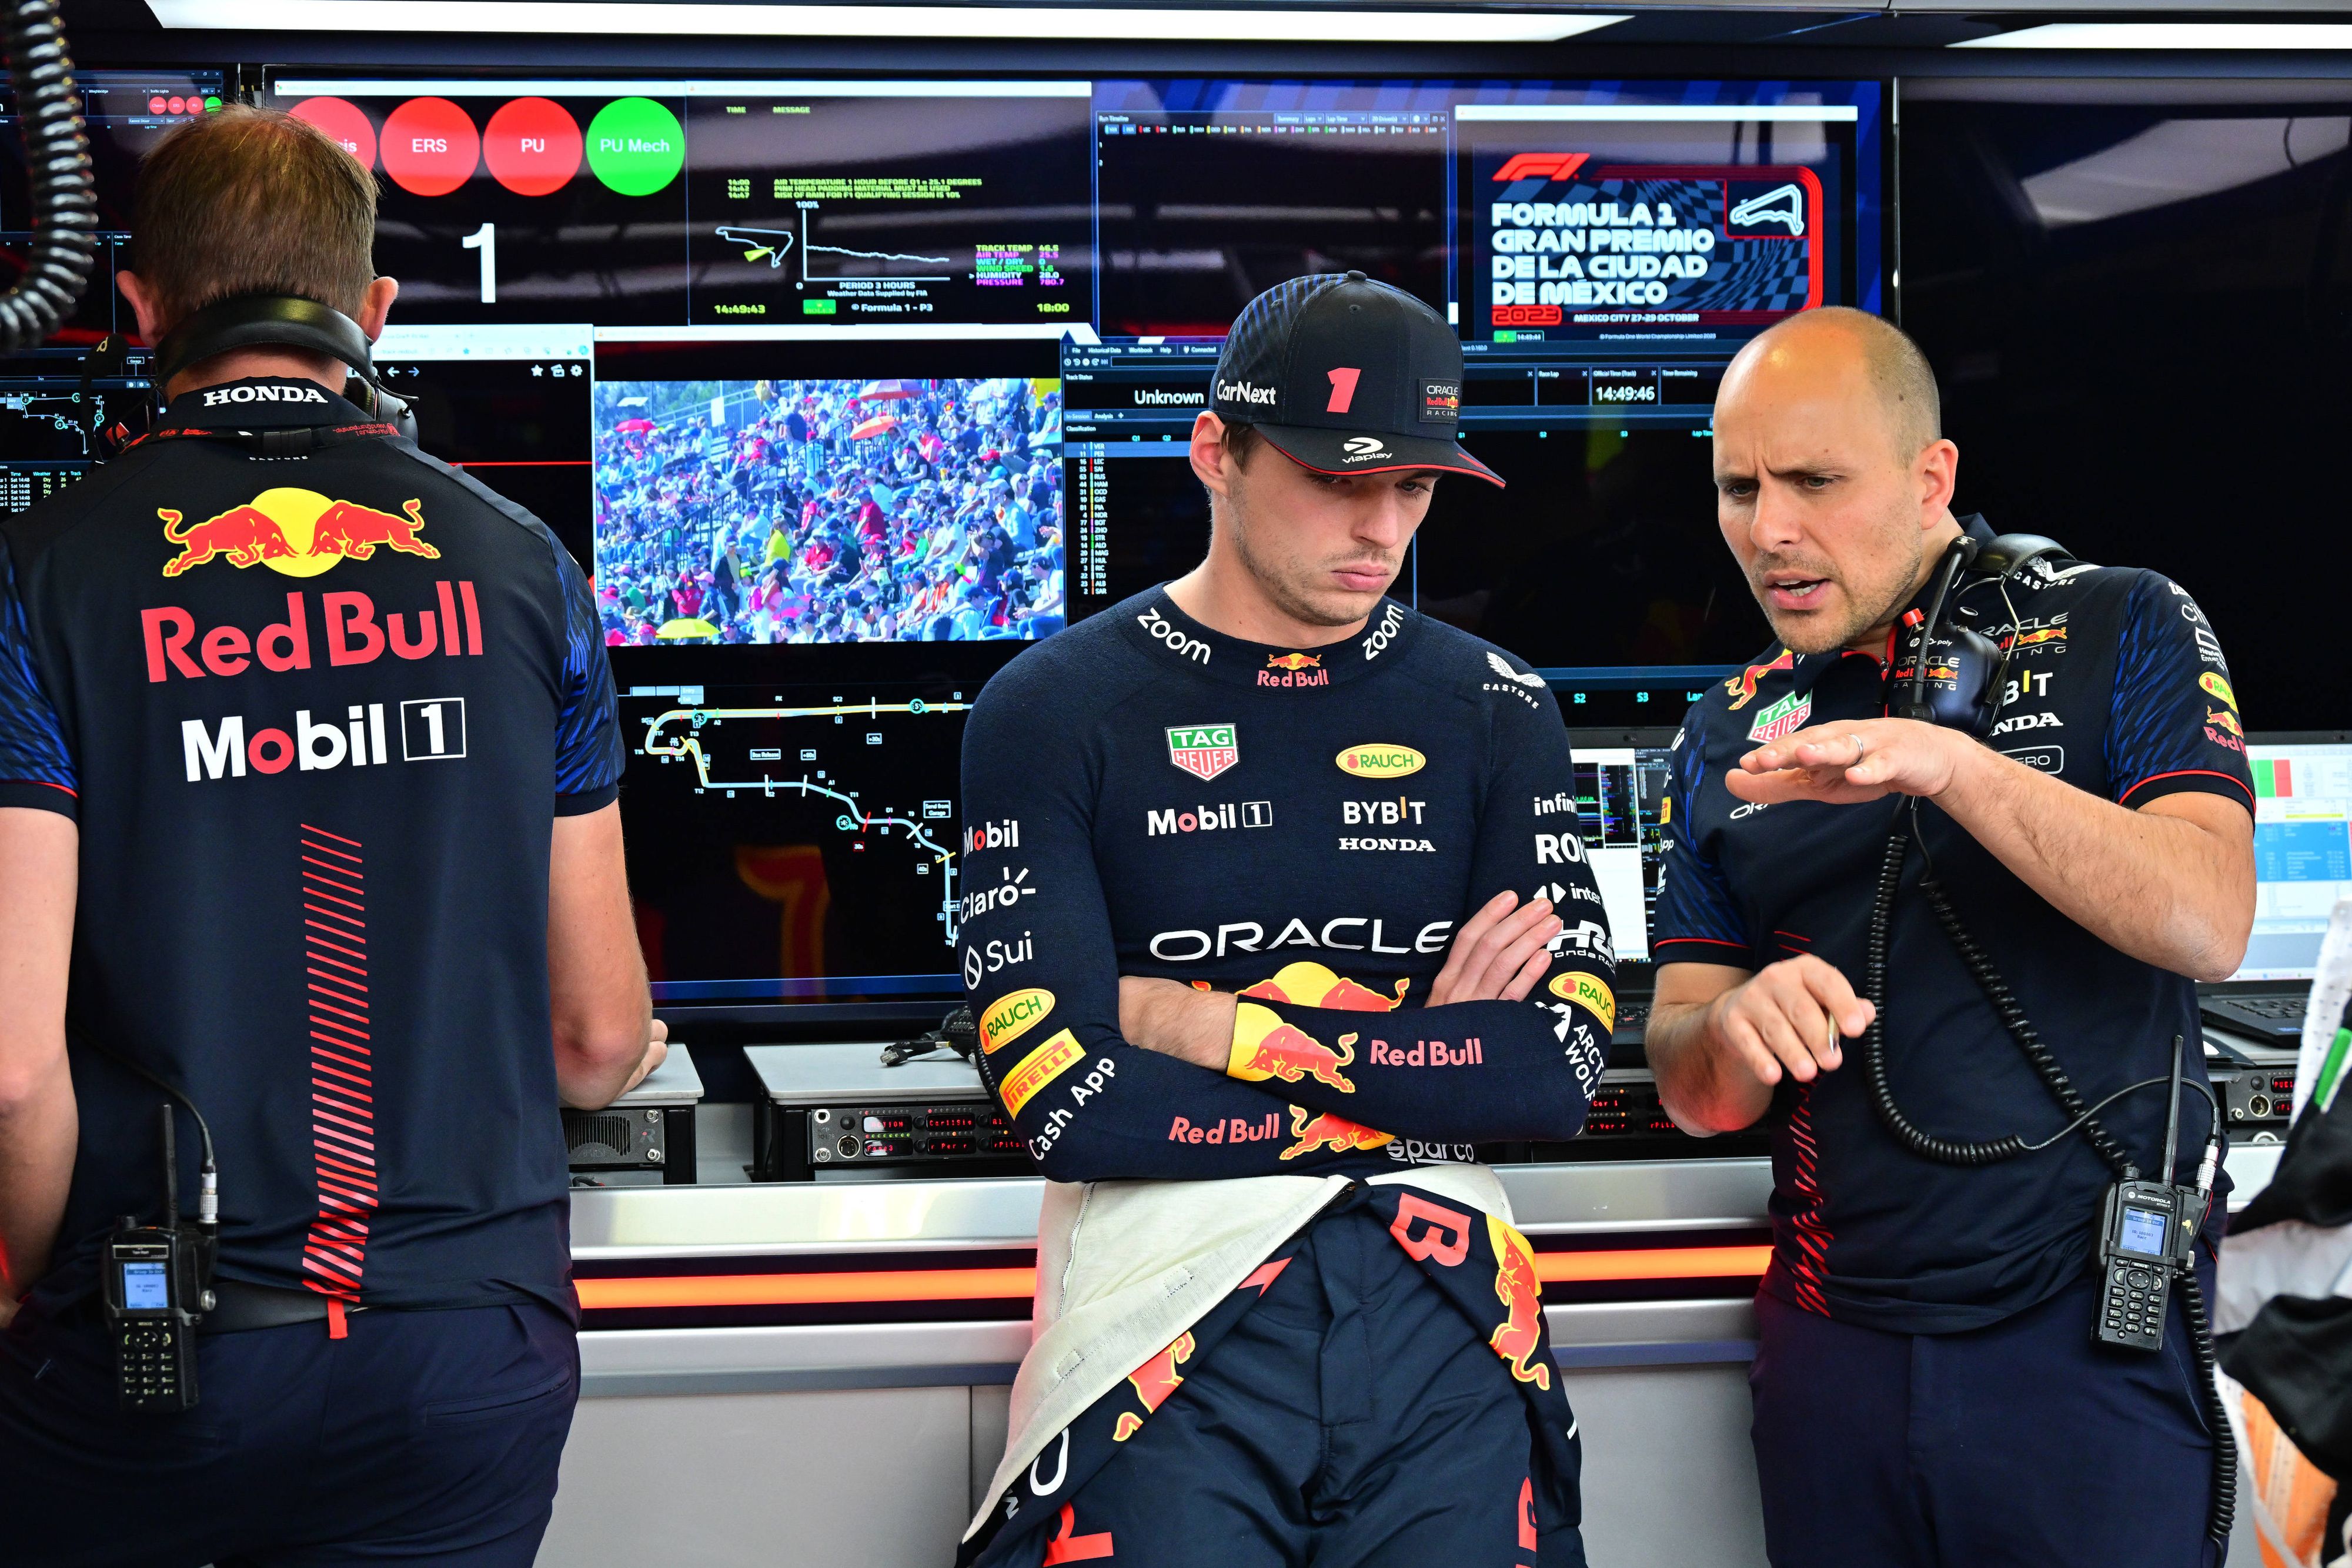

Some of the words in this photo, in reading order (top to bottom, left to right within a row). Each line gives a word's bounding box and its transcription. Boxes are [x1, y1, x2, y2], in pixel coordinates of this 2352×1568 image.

[773, 106, 811, 114] MESSAGE
[412, 139, 447, 152] ERS
[522, 139, 544, 152] PU
[600, 139, 623, 152] PU
[628, 139, 670, 152] Mech
[1492, 153, 1590, 181] F1
[796, 200, 819, 209] 100%
[1492, 202, 1654, 227] FORMULA
[1658, 203, 1676, 226] 1
[1492, 229, 1585, 253] GRAN
[1589, 229, 1715, 253] PREMIO
[463, 223, 496, 303] 1
[1492, 255, 1536, 279] DE
[1539, 255, 1585, 279] LA
[1589, 255, 1708, 279] CIUDAD
[1492, 282, 1536, 305] DE
[1539, 278, 1668, 305] MÉXICO
[714, 305, 765, 313] 14:49:43
[861, 303, 903, 312] Formula
[904, 303, 910, 312] 1
[920, 303, 933, 312] P3
[1037, 303, 1070, 312] 18:00
[1494, 306, 1561, 325] 2023
[1573, 313, 1609, 322] MEXICO
[1610, 313, 1630, 322] CITY
[1631, 313, 1656, 322] 27-29
[1658, 313, 1699, 322] OCTOBER
[203, 385, 328, 406] HONDA
[1135, 389, 1204, 404] Unknown
[1217, 379, 1276, 405] CarNext
[1327, 367, 1361, 413] 1
[1426, 396, 1438, 407] Red
[1427, 386, 1458, 396] ORACLE
[1596, 386, 1655, 402] 14:49:46
[141, 591, 311, 682] Red
[323, 581, 483, 666] Bull
[1362, 604, 1404, 660] zoom
[1979, 611, 2070, 636] RACLE
[1137, 607, 1211, 665] zoom
[1257, 670, 1294, 690] Red
[1295, 668, 1329, 687] Bull
[1893, 682, 1957, 691] RAING
[2002, 670, 2053, 707] BIT
[1483, 683, 1539, 709] CASTORE
[1573, 693, 1587, 704] S2
[1636, 691, 1649, 703] S3
[1990, 713, 2063, 737] NDA
[182, 704, 387, 781] Mobil
[419, 701, 447, 756] 1
[1174, 729, 1230, 747] TAG
[2203, 727, 2240, 751] Red
[1176, 750, 1235, 776] HEUER
[1359, 753, 1414, 768] RAUCH
[1344, 797, 1425, 824] BYBIT
[1534, 792, 1578, 816] infini
[1148, 804, 1236, 835] Mobil
[1250, 804, 1261, 825] 1
[964, 820, 1018, 857] Mobil
[1339, 838, 1436, 851] HONDA
[960, 884, 1018, 924] Claro
[987, 931, 1032, 972] Sui
[1149, 918, 1452, 961] ORACLE
[1554, 950, 1596, 959] onda
[988, 995, 1043, 1041] RAUCH
[1371, 1040, 1424, 1066] Red
[1429, 1038, 1482, 1066] Bull
[1573, 1024, 1605, 1085] ARCTI
[1002, 1039, 1073, 1110] PIRELLI
[1565, 1039, 1596, 1101] WOLF
[1029, 1109, 1073, 1160] Cash
[1070, 1058, 1115, 1105] App
[1168, 1116, 1226, 1144] Red
[1230, 1114, 1279, 1143] Bull
[1387, 1139, 1474, 1164] sparco
[2137, 1195, 2171, 1204] MOTOROLA
